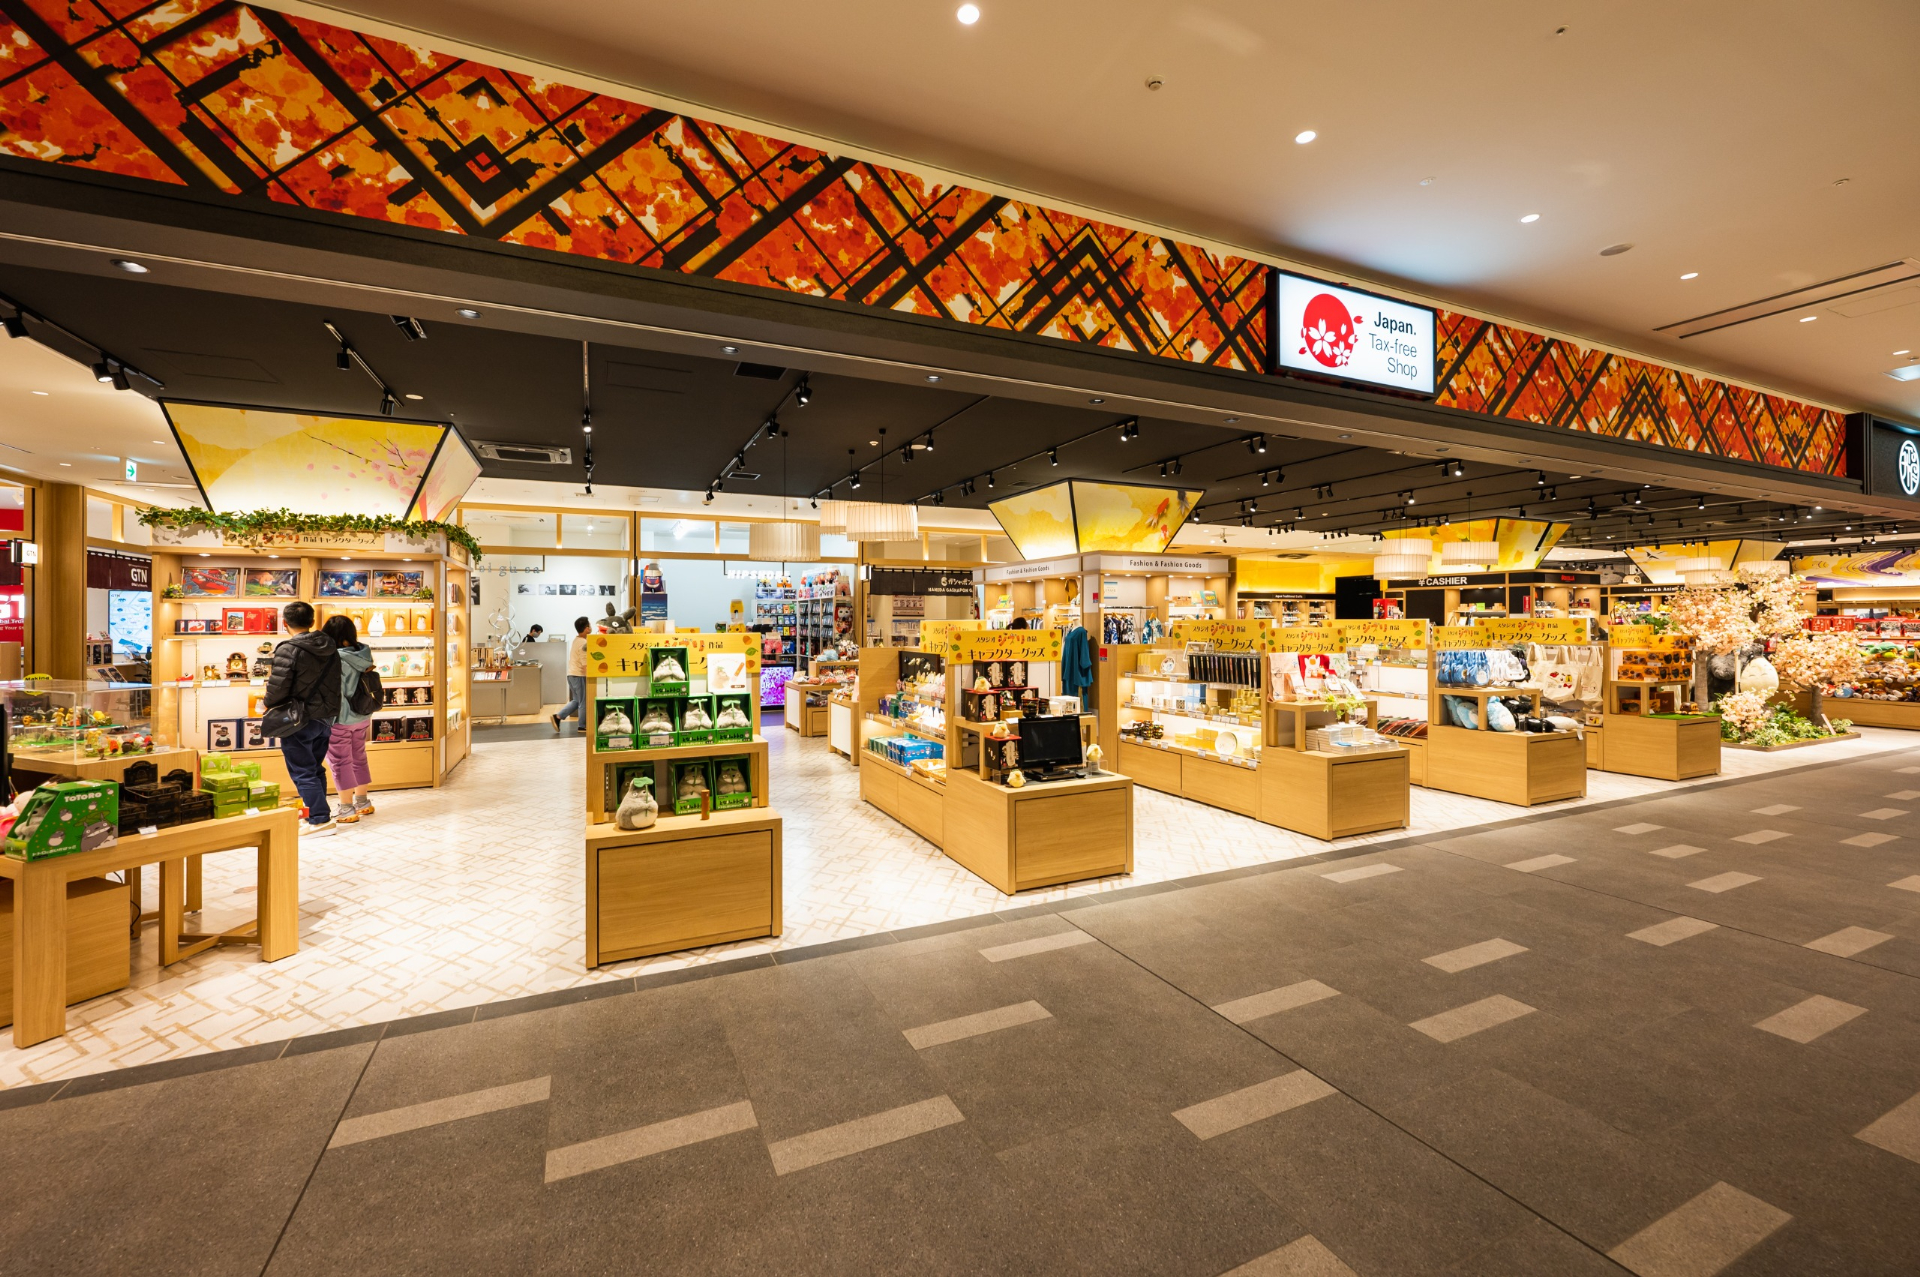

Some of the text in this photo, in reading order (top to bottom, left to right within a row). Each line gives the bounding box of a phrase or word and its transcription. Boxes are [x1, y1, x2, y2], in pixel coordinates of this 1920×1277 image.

[1373, 311, 1417, 336] Japan.
[1368, 332, 1418, 358] Tax-free
[1387, 357, 1418, 380] Shop
[1024, 566, 1037, 574] Fashion
[1129, 559, 1153, 567] Fashion
[1160, 560, 1183, 568] Fashion
[1184, 561, 1202, 569] Goods
[130, 568, 148, 583] GTN
[1426, 576, 1468, 586] CASHIER
[967, 647, 1046, 660] キャラクターグッズ
[1279, 642, 1335, 653] キャラクターグッズ
[64, 792, 102, 802] TOTORO
